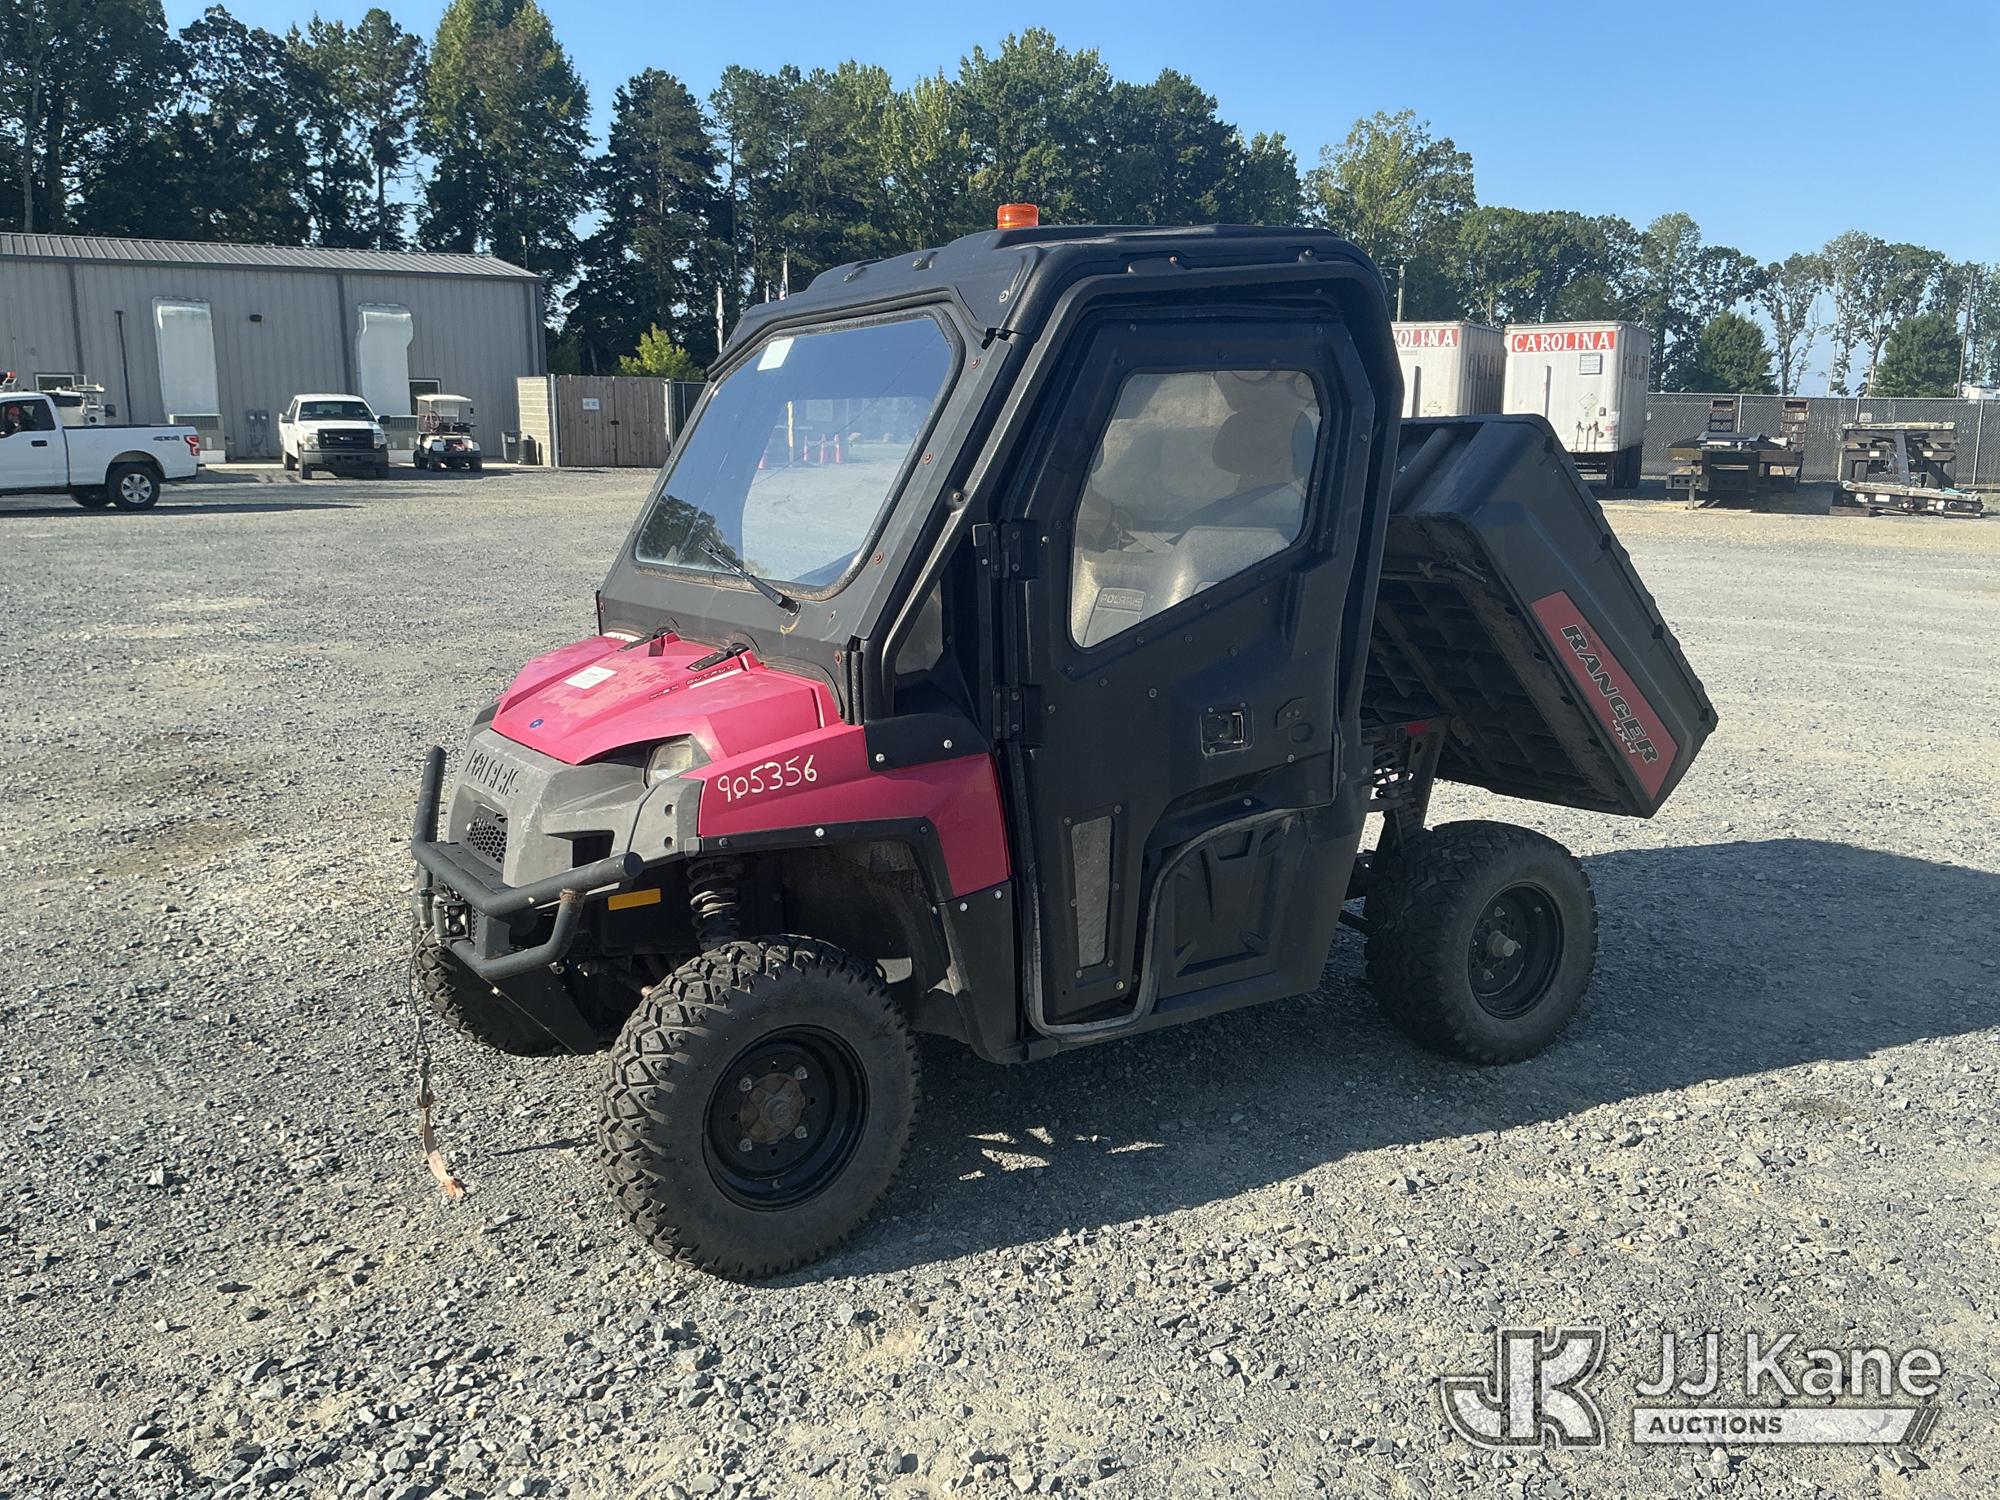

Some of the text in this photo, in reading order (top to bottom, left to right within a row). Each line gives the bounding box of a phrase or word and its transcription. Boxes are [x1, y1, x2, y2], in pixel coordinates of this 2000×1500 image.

[1513, 332, 1610, 352] CAROLINA
[1560, 624, 1659, 764] RANGER
[717, 754, 818, 803] 905356
